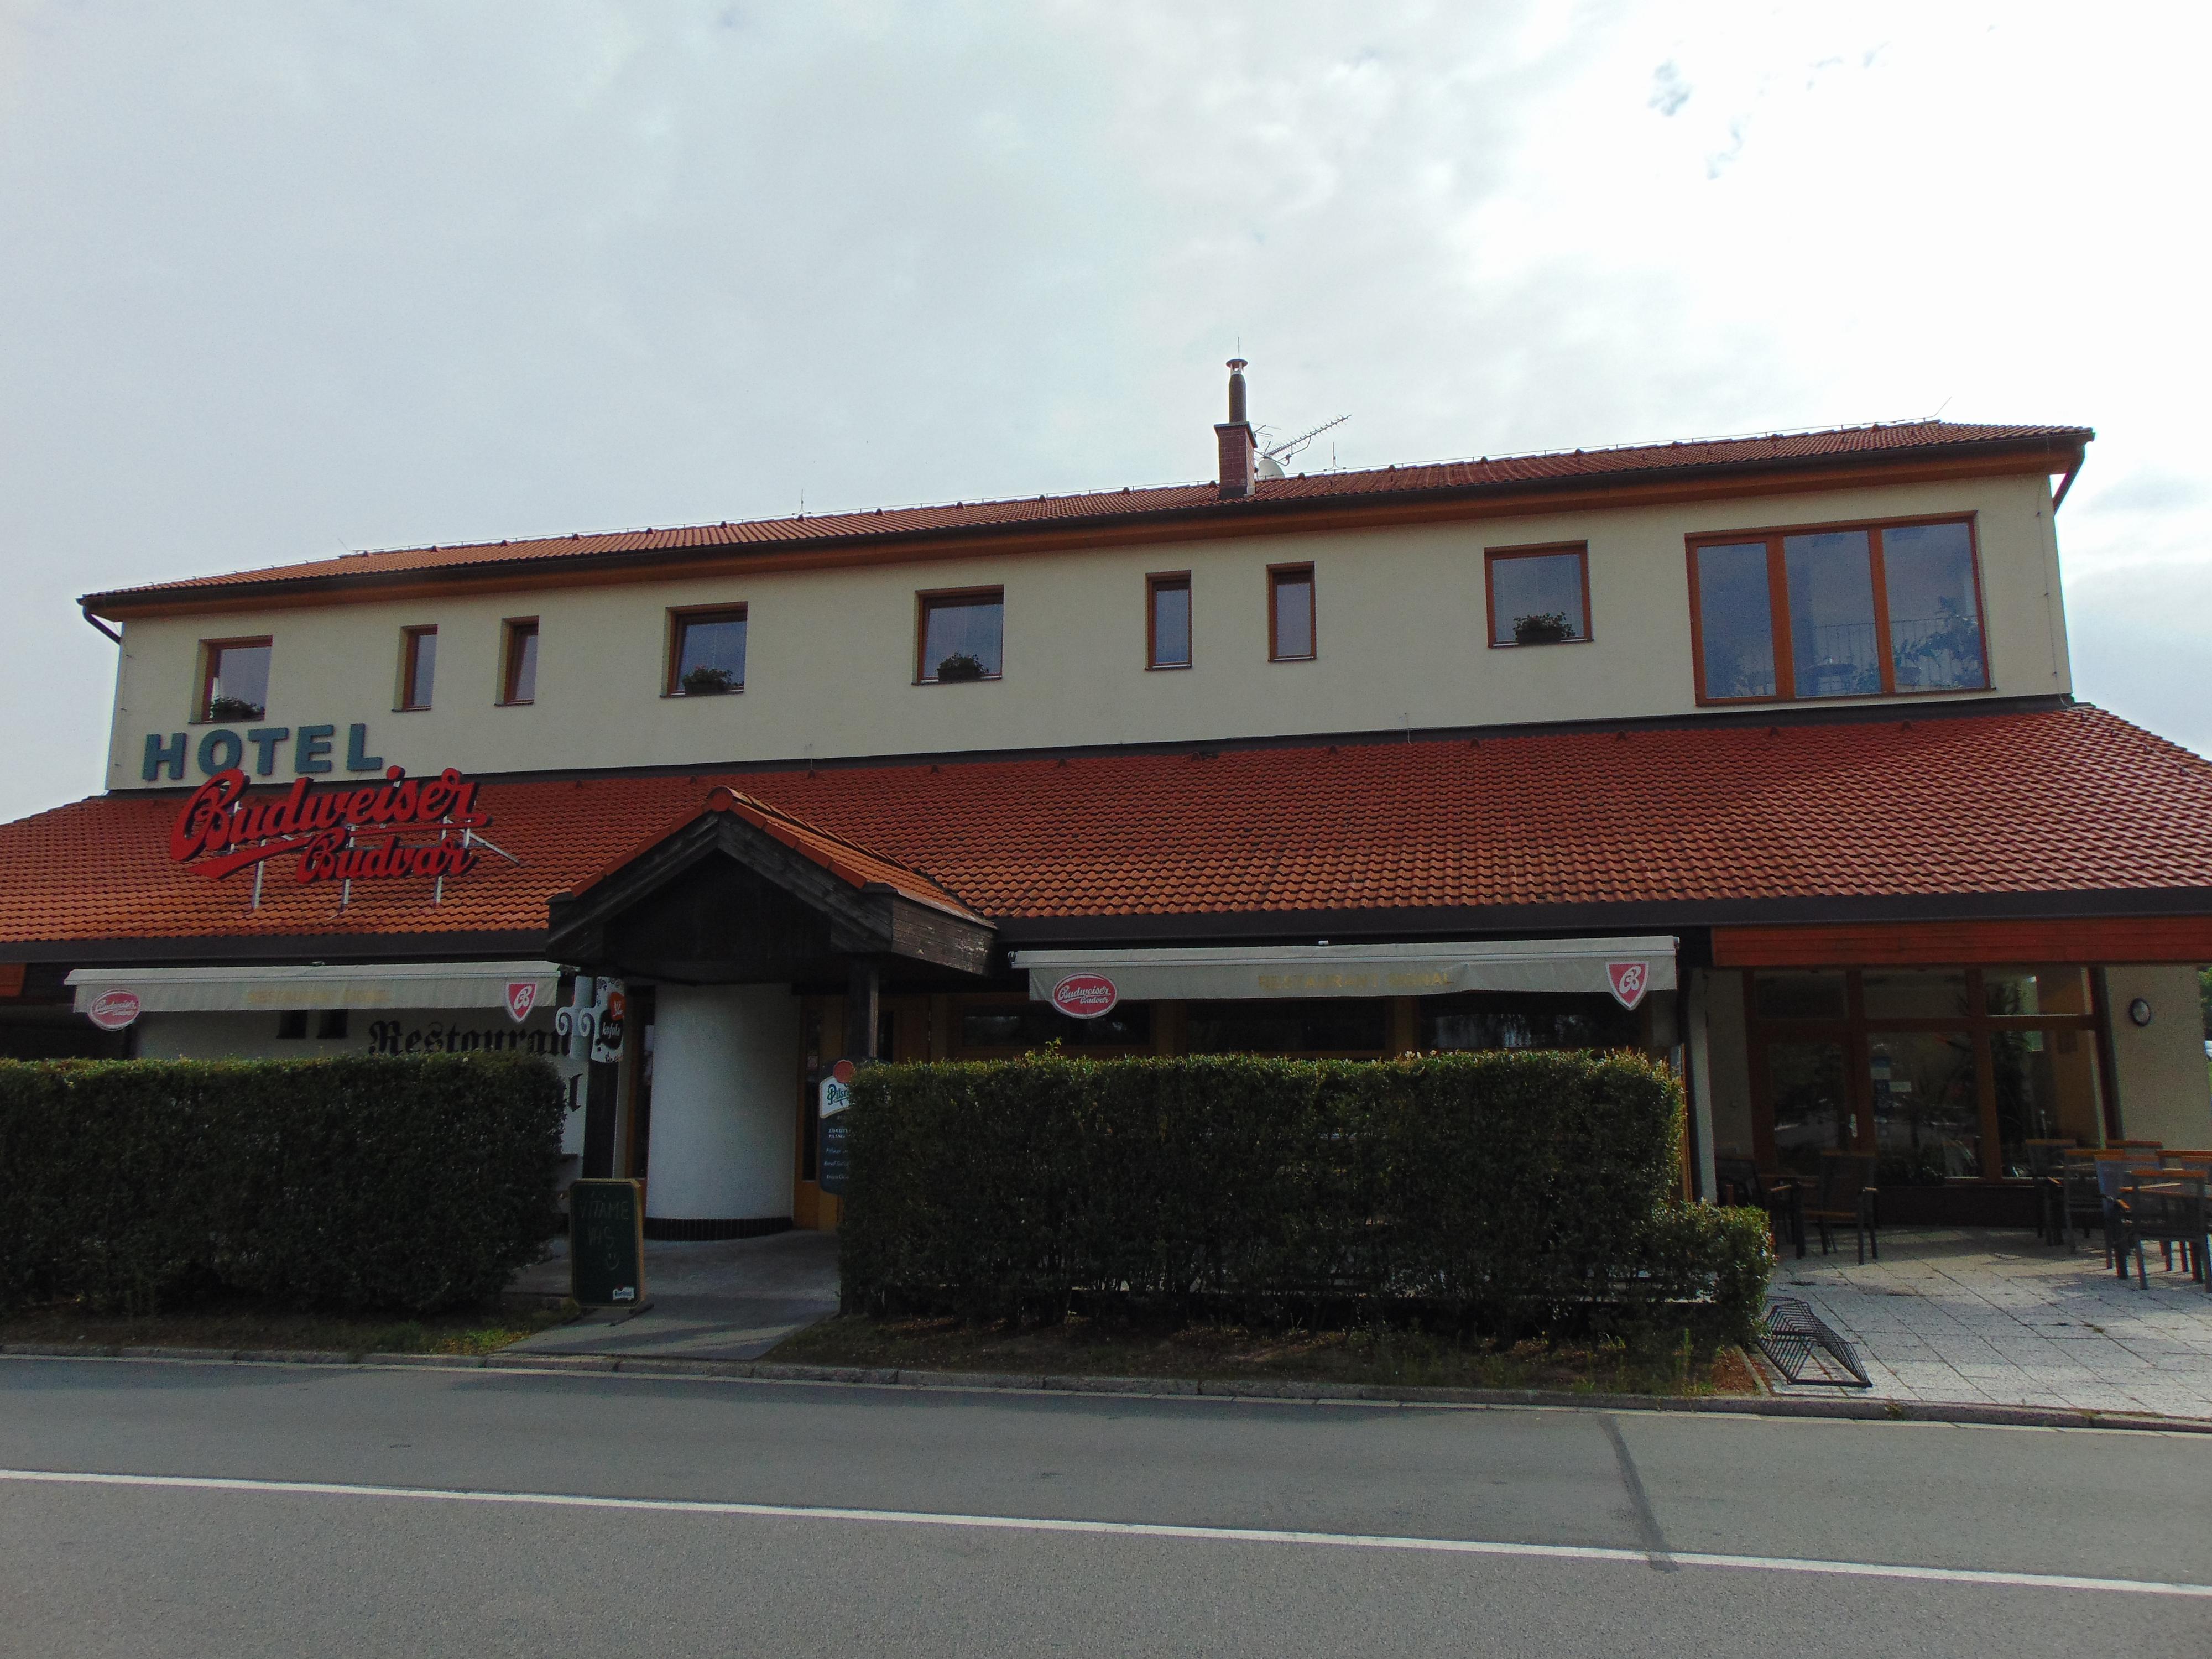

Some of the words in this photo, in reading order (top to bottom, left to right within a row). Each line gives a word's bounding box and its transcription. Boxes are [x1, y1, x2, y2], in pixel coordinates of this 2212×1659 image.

[142, 723, 383, 780] HOTEL
[170, 765, 477, 862] Budweiser
[295, 828, 478, 883] Budvar
[1058, 985, 1109, 1000] Budweiser
[1080, 995, 1109, 1004] Budvar
[369, 1020, 573, 1057] Restauran
[602, 1022, 620, 1039] kofola
[827, 1083, 850, 1105] Pilsn
